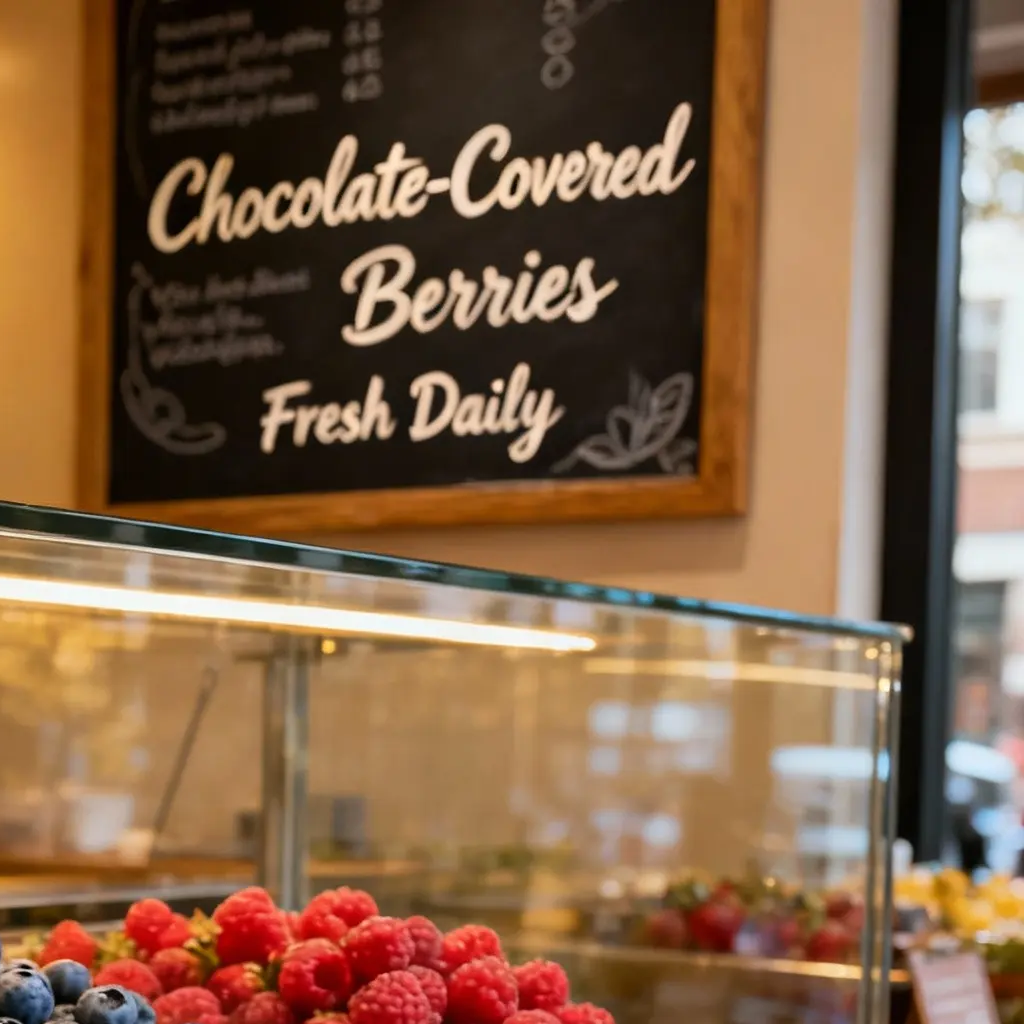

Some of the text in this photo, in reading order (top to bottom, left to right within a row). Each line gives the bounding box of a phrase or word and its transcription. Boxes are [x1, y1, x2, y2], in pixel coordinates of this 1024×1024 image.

[148, 102, 696, 253] Chocolate-Covered
[340, 244, 619, 347] Berries
[260, 362, 564, 463] Fresh Daily
